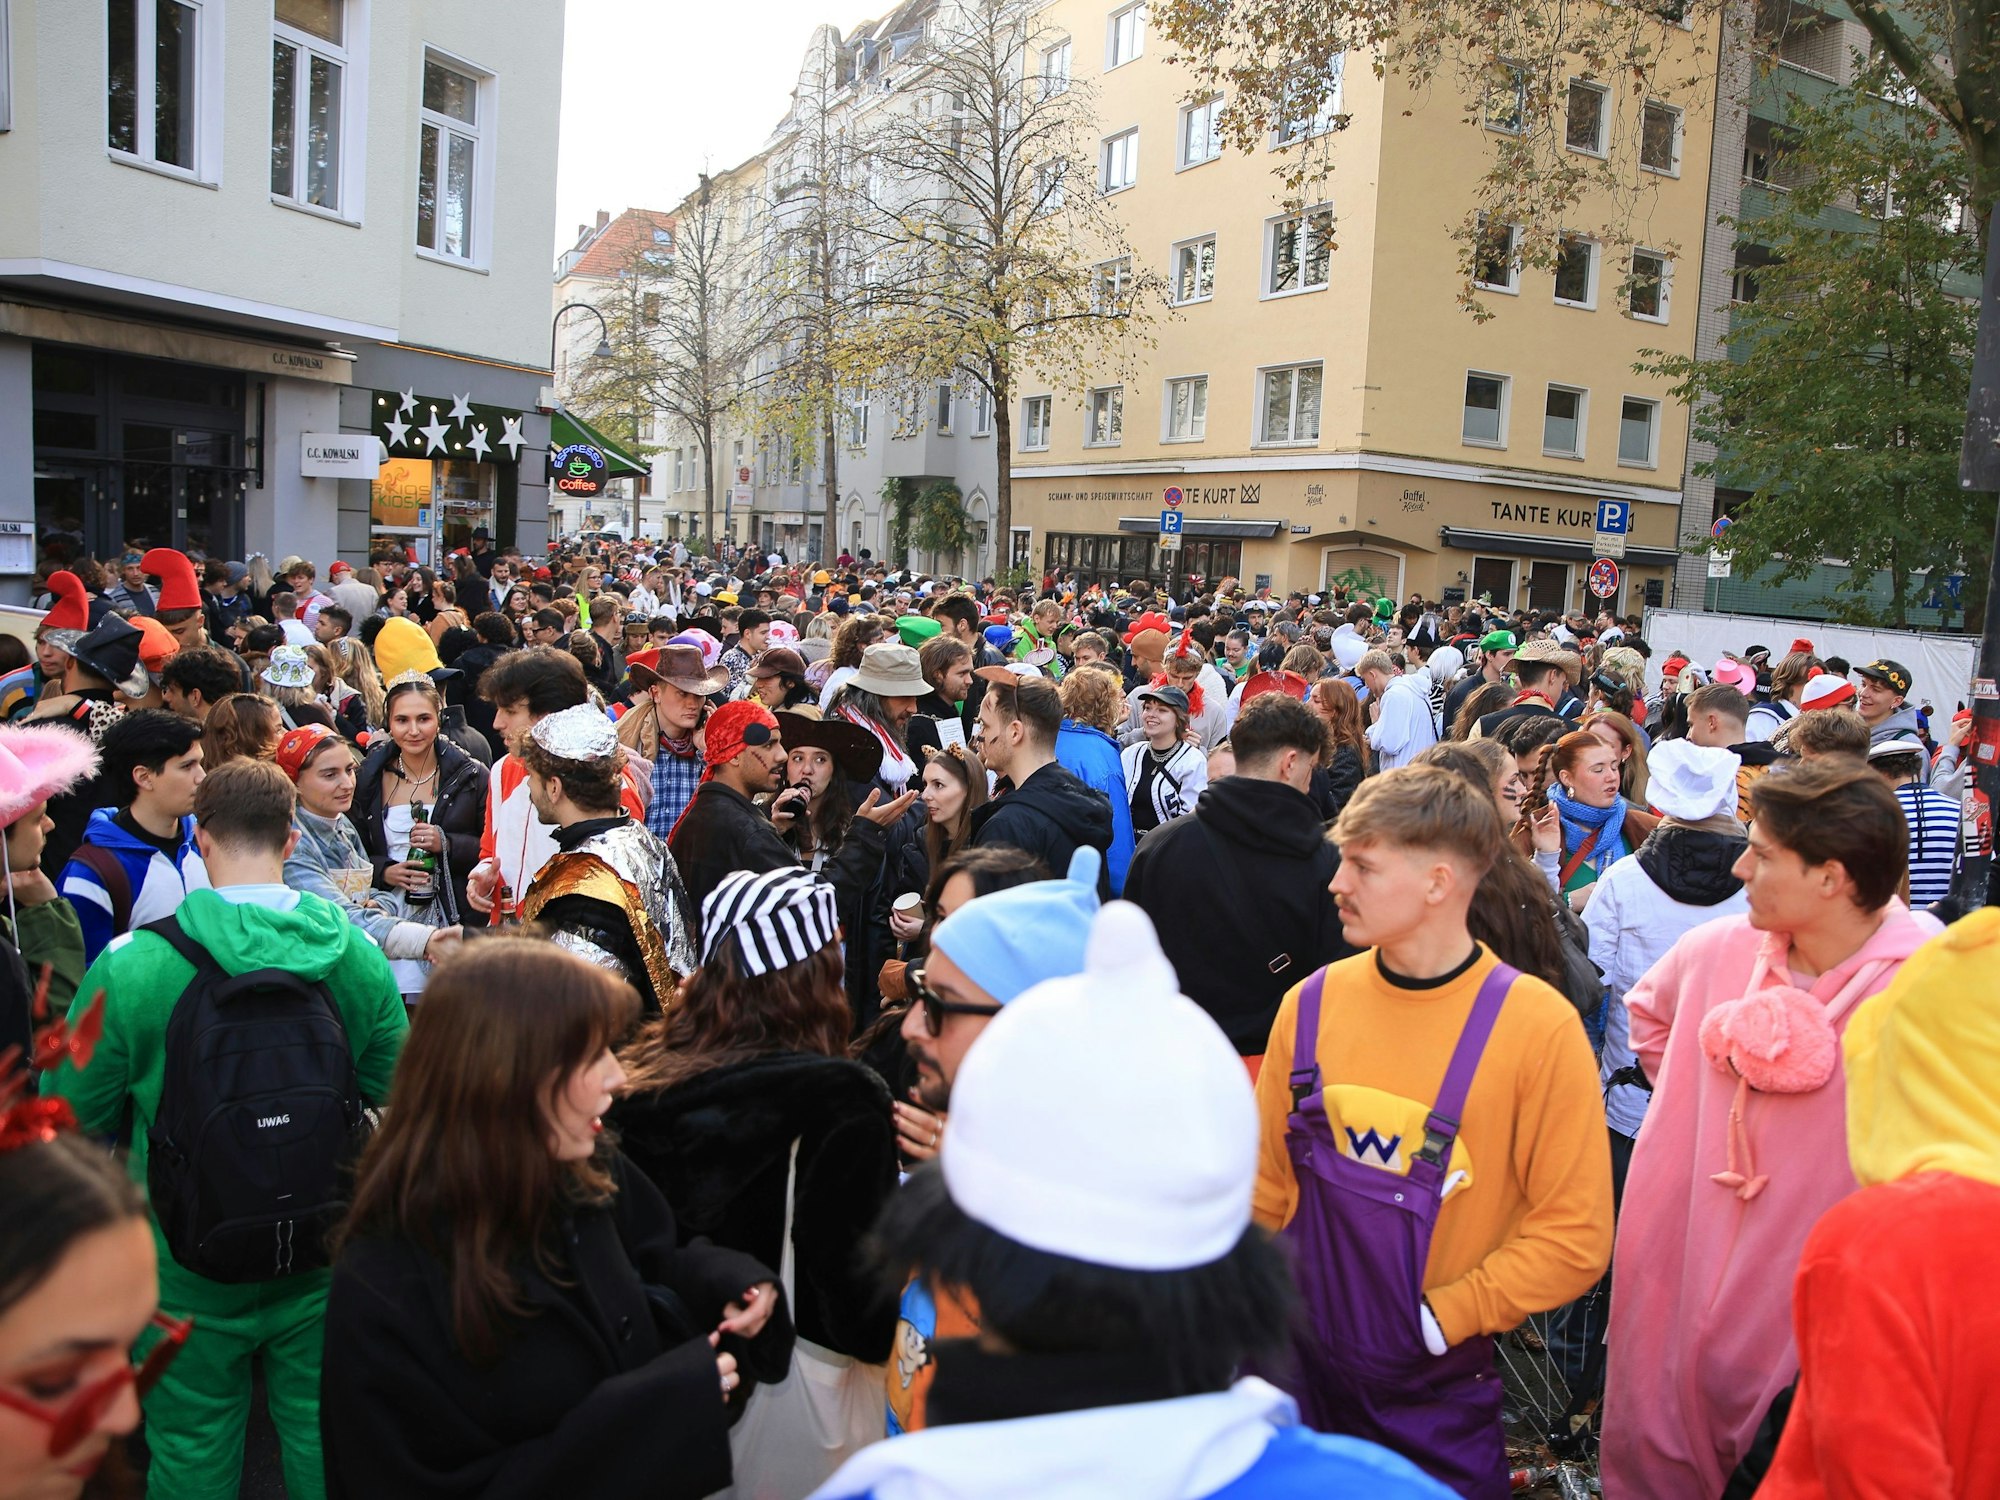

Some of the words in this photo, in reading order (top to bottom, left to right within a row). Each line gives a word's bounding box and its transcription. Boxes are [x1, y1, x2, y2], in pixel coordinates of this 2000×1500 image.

[289, 355, 324, 370] KOWALSKI
[307, 447, 321, 459] C.C.
[323, 448, 359, 460] KOWALSKI
[554, 444, 604, 469] ESPRESSO
[559, 479, 597, 491] Coffee
[1307, 484, 1324, 495] Gaffel
[1075, 492, 1088, 501] UND
[1091, 491, 1153, 502] SPEISEWIRTSCHAFT
[1203, 487, 1236, 505] KURT
[1403, 489, 1425, 502] Gaffel
[1165, 513, 1178, 531] P
[1491, 502, 1550, 524] TANTE
[1557, 508, 1597, 529] KUR
[1603, 503, 1622, 528] P
[0, 523, 21, 532] ALSKI
[1756, 684, 1772, 693] SWAT
[1344, 1126, 1402, 1164] W
